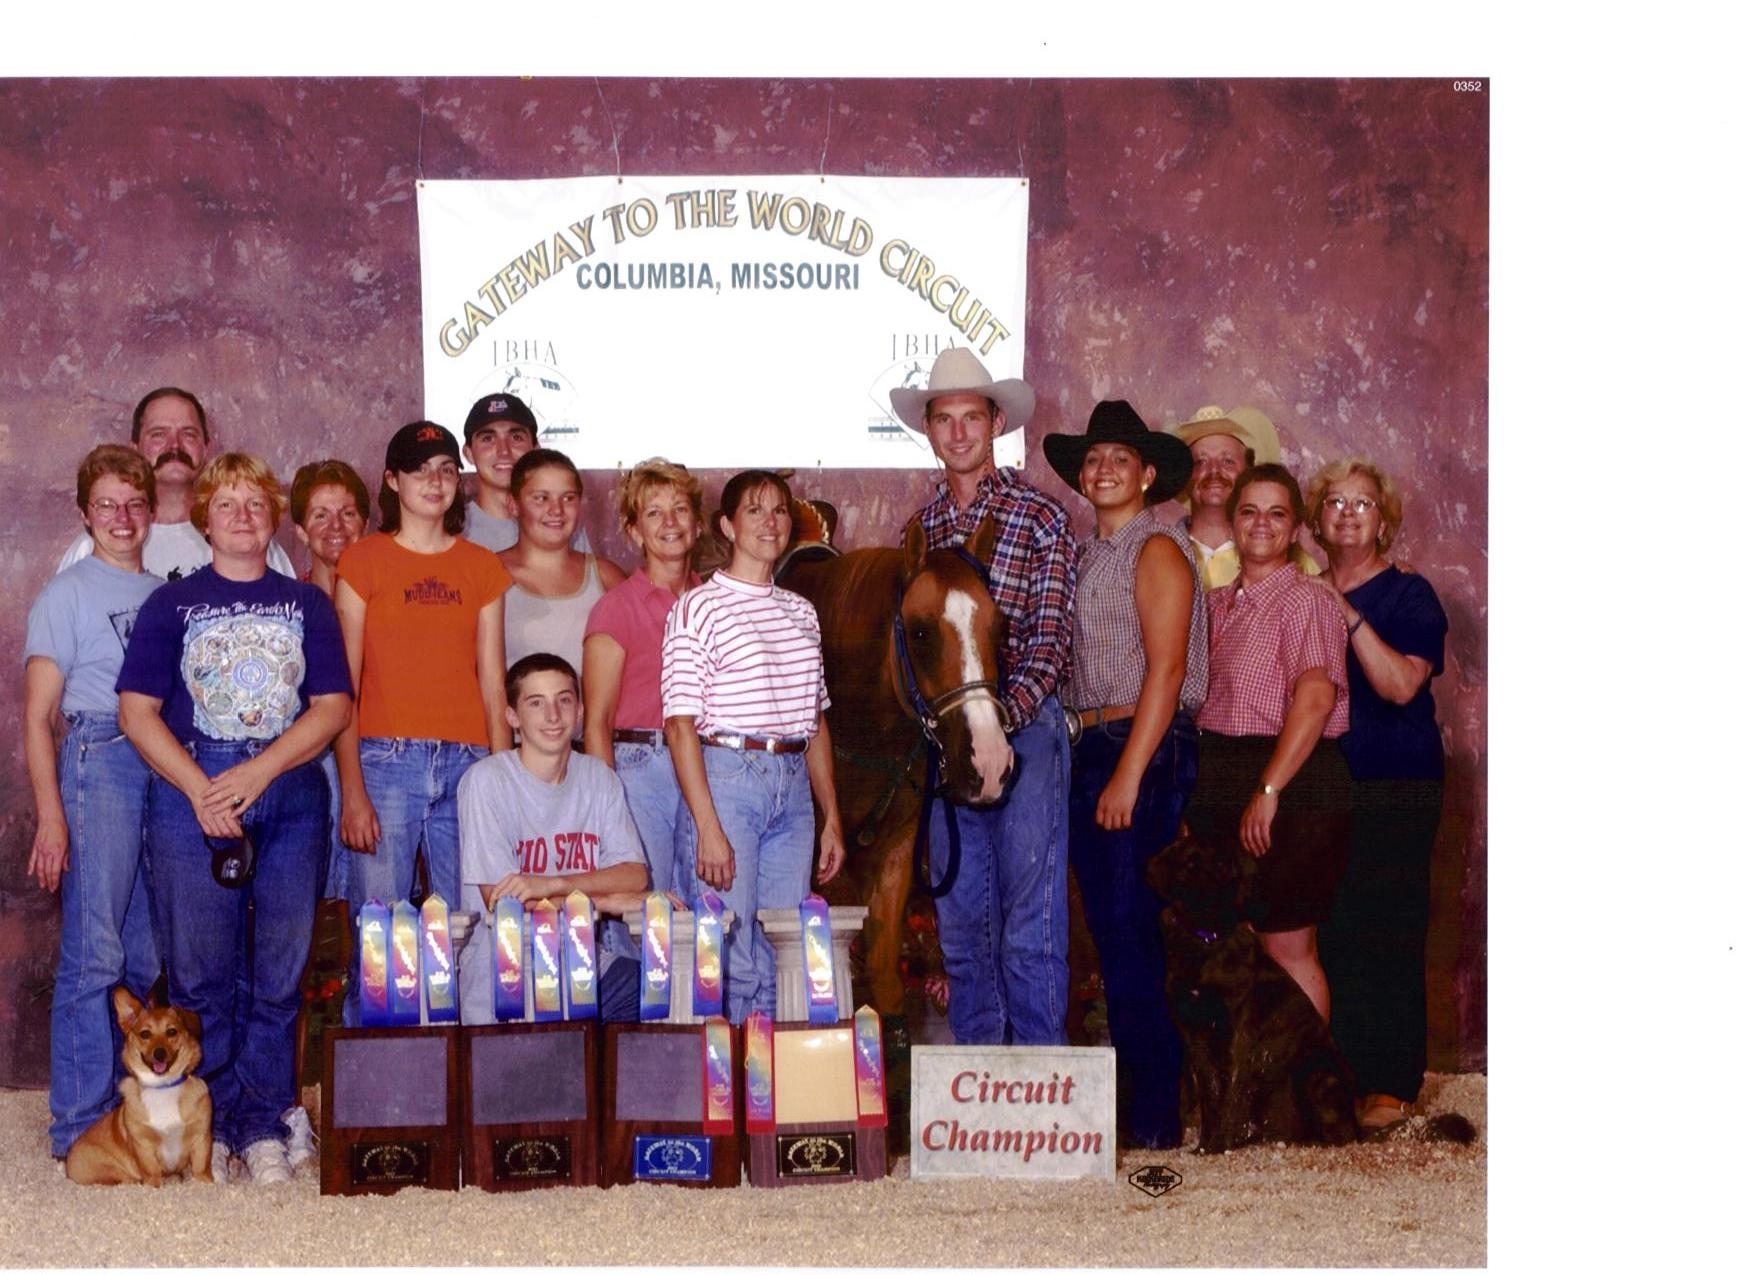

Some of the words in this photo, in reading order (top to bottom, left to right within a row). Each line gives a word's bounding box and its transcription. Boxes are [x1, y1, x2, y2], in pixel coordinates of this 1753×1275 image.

[439, 214, 596, 358] GATEWAY
[602, 197, 658, 244] TO
[665, 189, 739, 230] THE
[746, 190, 874, 257] WORLD
[880, 239, 1012, 356] CIRCUIT
[576, 262, 721, 295] COLUMBIA,
[731, 262, 860, 290] MISSOURI
[492, 339, 558, 366] IBHA
[554, 832, 600, 872] STAT
[950, 1071, 1076, 1105] Circuit
[922, 1120, 1103, 1163] Champion
